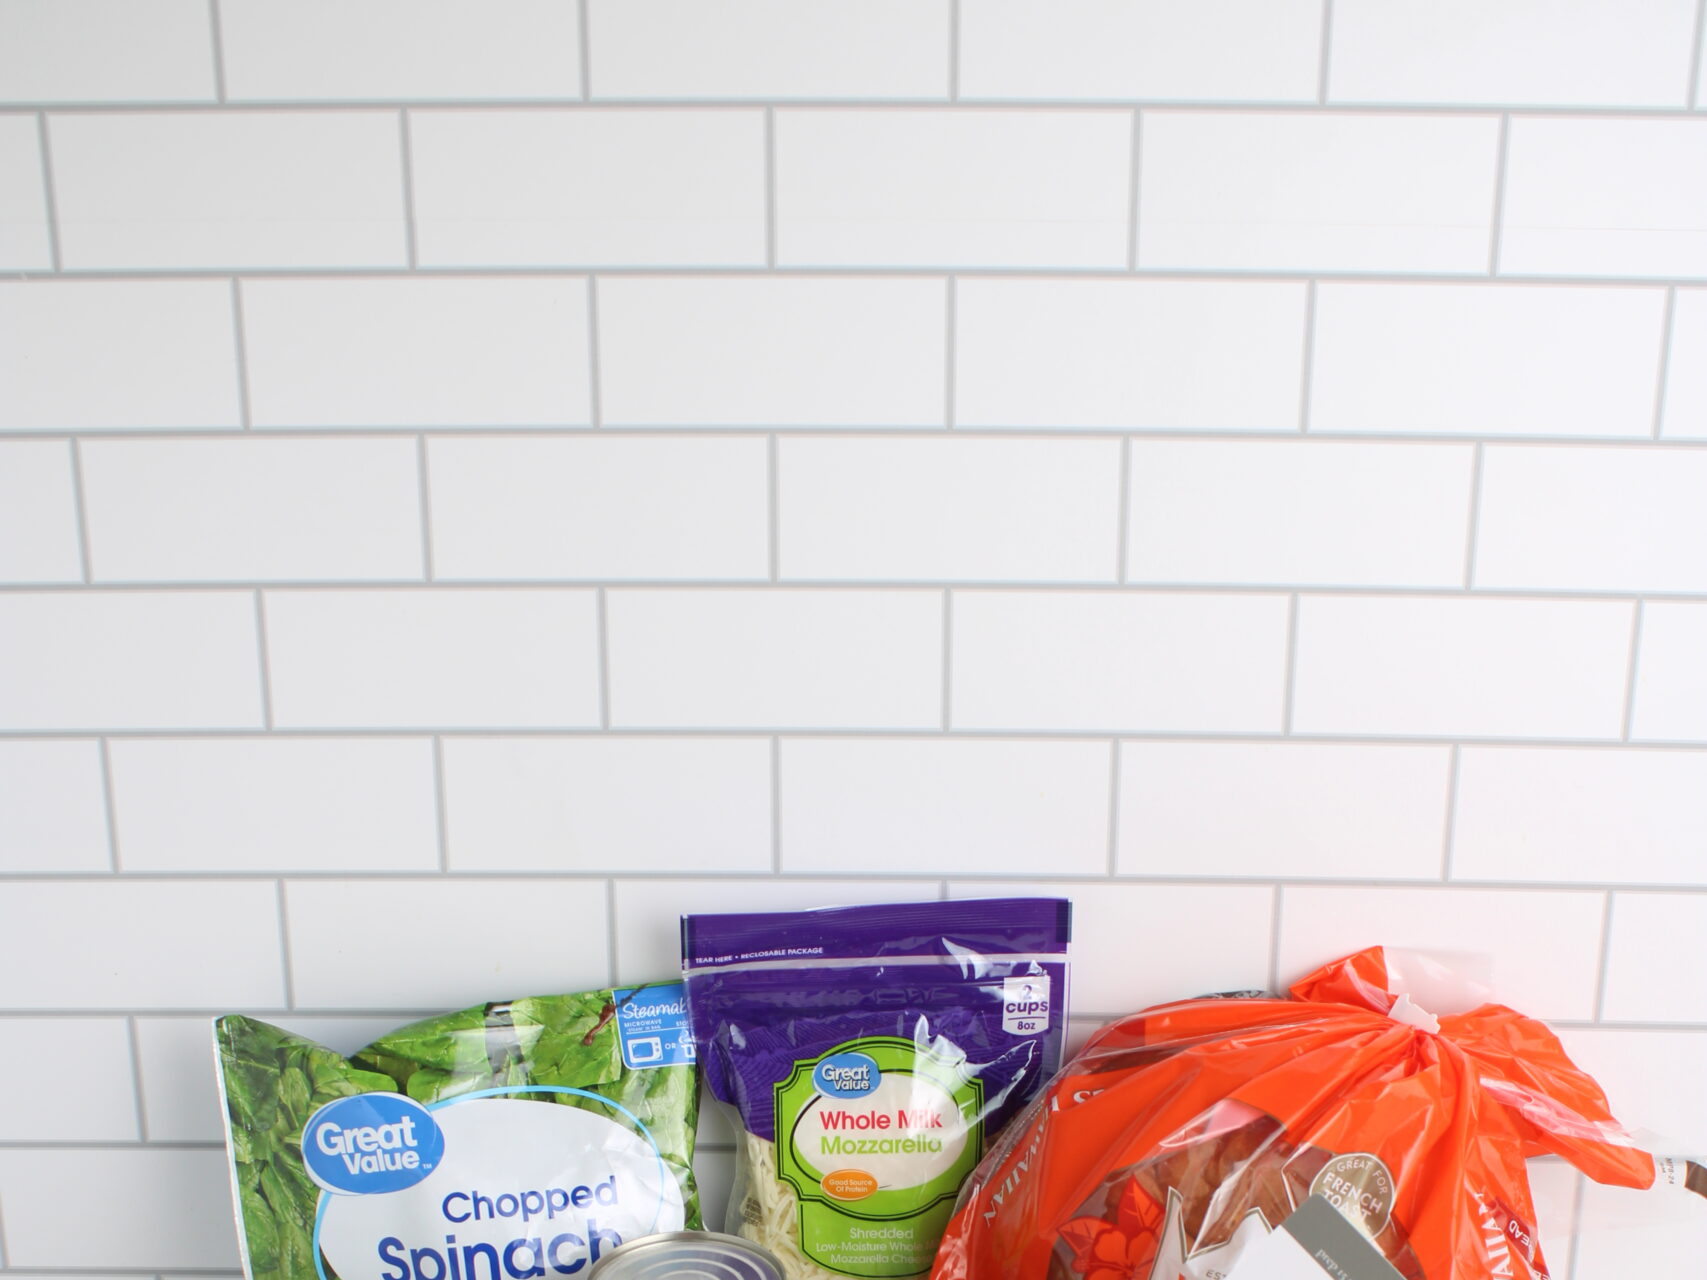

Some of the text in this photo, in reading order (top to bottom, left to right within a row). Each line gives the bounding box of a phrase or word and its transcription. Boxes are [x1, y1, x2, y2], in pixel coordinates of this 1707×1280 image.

[695, 947, 824, 964] TEAR HERE RECLOSABLE PACKAGE
[1005, 1001, 1048, 1015] cups
[624, 1018, 662, 1028] MICROWAVE
[1017, 1021, 1036, 1030] 8oz
[664, 1042, 677, 1050] OR
[821, 1064, 870, 1081] Great
[833, 1079, 870, 1091] Value
[819, 1109, 943, 1130] Whole Milk
[316, 1115, 418, 1156] Great
[820, 1134, 942, 1155] Mozzarella
[342, 1149, 420, 1175] Value
[828, 1179, 873, 1187] Good Source
[1336, 1158, 1389, 1194] GREAT FOR
[442, 1175, 618, 1223] Chopped
[1322, 1172, 1384, 1214] FRENCH
[1323, 1188, 1372, 1219] TOAST
[850, 1227, 913, 1239] Shredded
[816, 1241, 887, 1252] Low-Moisture
[830, 1254, 889, 1264] Mozzarella
[1315, 1248, 1338, 1270] prep
